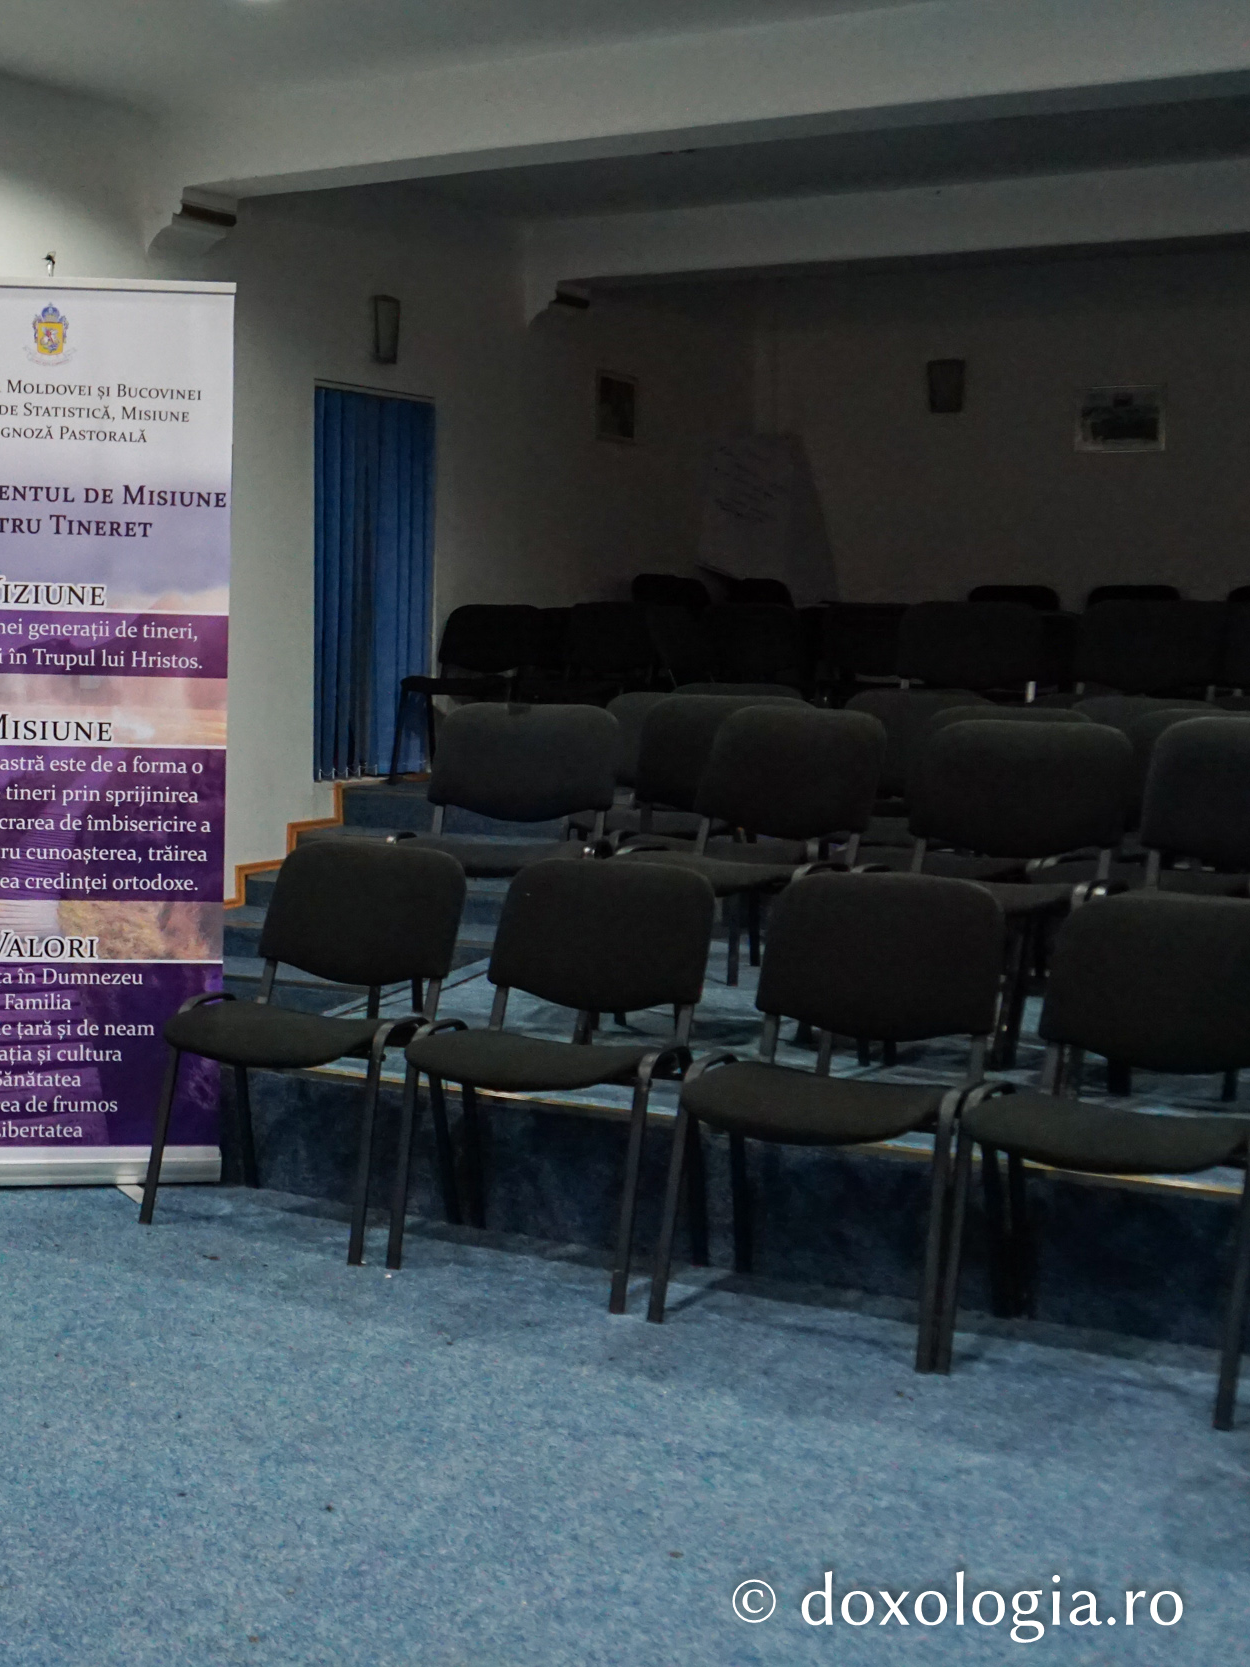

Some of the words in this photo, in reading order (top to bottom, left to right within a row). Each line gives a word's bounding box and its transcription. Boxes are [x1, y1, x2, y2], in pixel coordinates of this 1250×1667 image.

[28, 621, 109, 642] generații
[115, 622, 137, 637] de
[143, 623, 197, 641] tineri,
[9, 649, 27, 664] în
[33, 648, 96, 670] Trupul
[102, 649, 124, 666] lui
[131, 651, 203, 669] Hristos.
[50, 758, 86, 772] este
[91, 756, 113, 772] de
[117, 760, 127, 773] a
[133, 756, 187, 773] forma
[192, 761, 203, 774] o
[6, 785, 56, 800] tineri
[62, 787, 100, 805] prin
[106, 788, 198, 806] sprijinirea
[59, 815, 82, 831] de
[87, 815, 196, 833] îmbisericire
[201, 821, 211, 833] a
[26, 846, 142, 865] cunoașterea,
[148, 847, 207, 862] trăirea
[25, 873, 107, 893] credinței
[112, 874, 197, 891] ortodoxe.
[17, 969, 36, 985] în
[42, 969, 143, 985] Dumnezeu
[4, 994, 71, 1011] Familia
[17, 1022, 52, 1040] țară
[57, 1021, 72, 1040] și
[77, 1020, 98, 1036] de
[104, 1024, 154, 1036] neam
[37, 1047, 51, 1066] și
[57, 1046, 122, 1061] cultura
[26, 1097, 48, 1113] de
[53, 1097, 118, 1113] frumos
